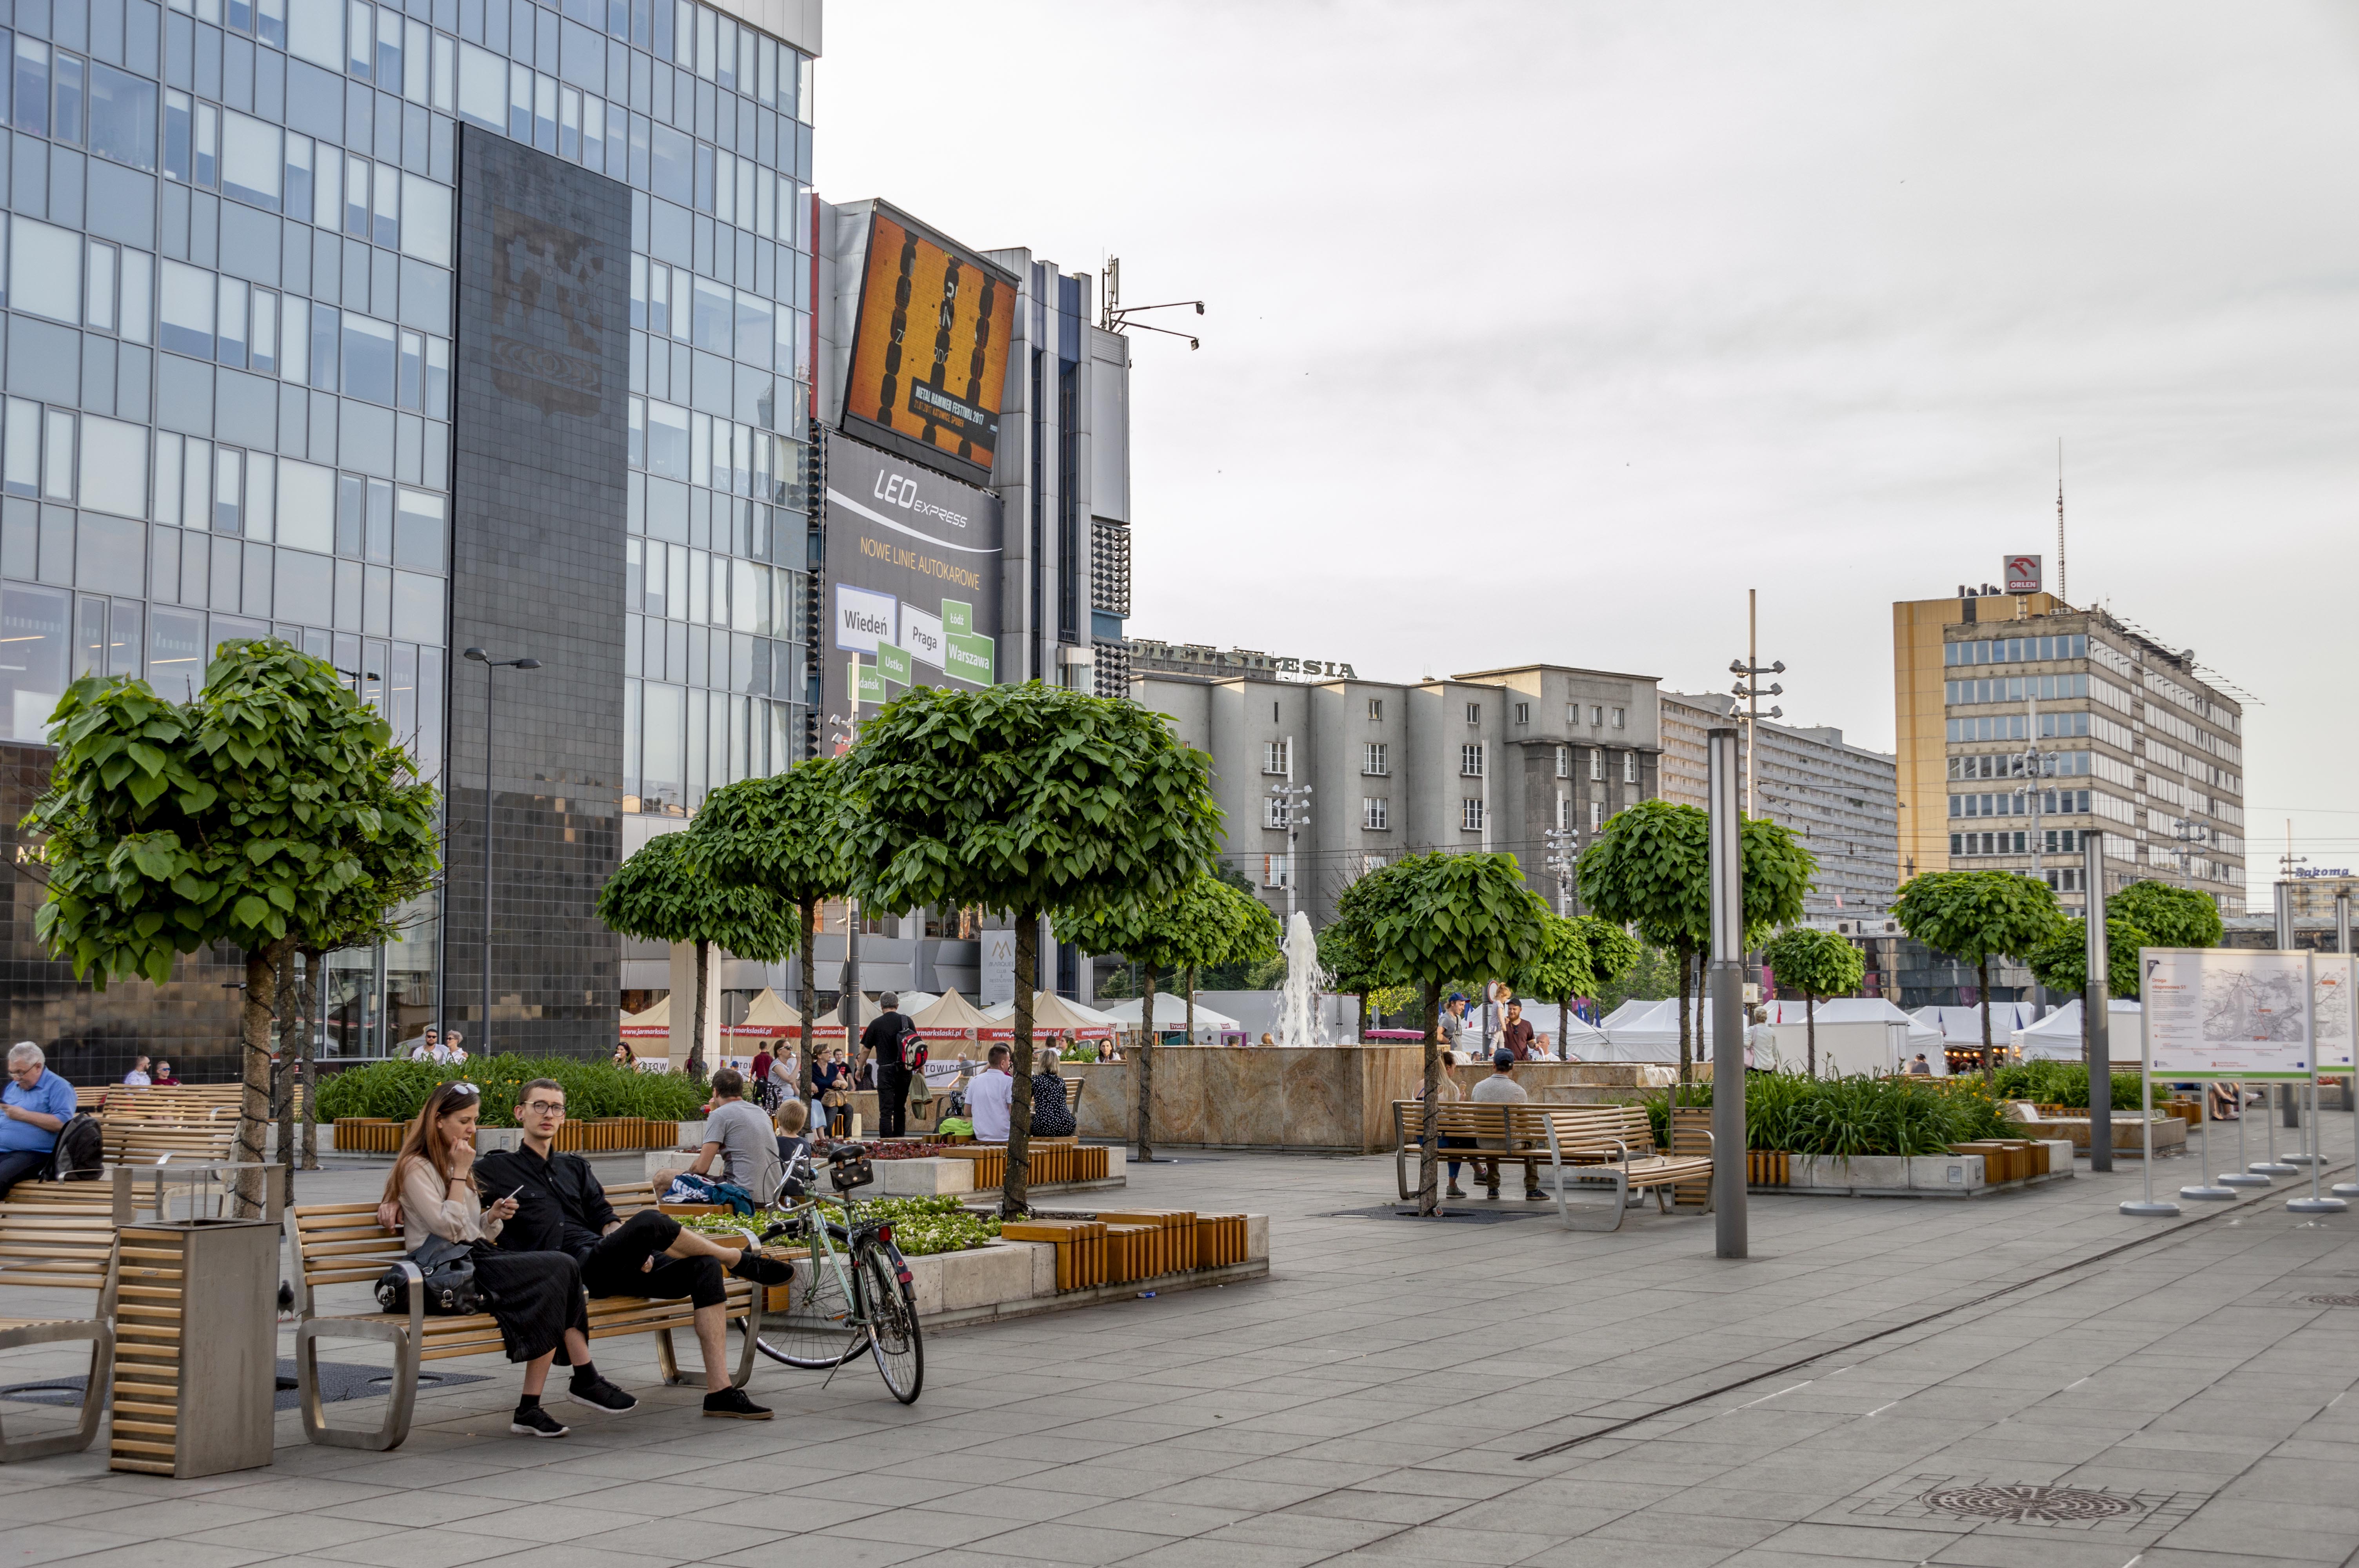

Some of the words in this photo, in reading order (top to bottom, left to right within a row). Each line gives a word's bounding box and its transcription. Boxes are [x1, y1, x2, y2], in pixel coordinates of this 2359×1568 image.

[915, 385, 931, 403] METAL
[931, 392, 952, 412] HAMMER
[952, 401, 973, 421] FESTIVAL
[972, 411, 984, 425] 2017
[874, 469, 917, 509] LEO
[914, 499, 967, 528] EXPRESS
[860, 536, 891, 562] NOWE
[893, 546, 916, 570] LINIE
[918, 555, 980, 590] AUTOKAROWE
[844, 610, 887, 635] Wiedeń
[950, 613, 964, 626] Łódź
[913, 626, 937, 651] Praga
[885, 655, 903, 673] Ustka
[948, 643, 989, 670] Warszawa
[1129, 641, 1216, 665] OTEL
[1224, 651, 1358, 679] SILESIA
[859, 677, 879, 690] dańsk
